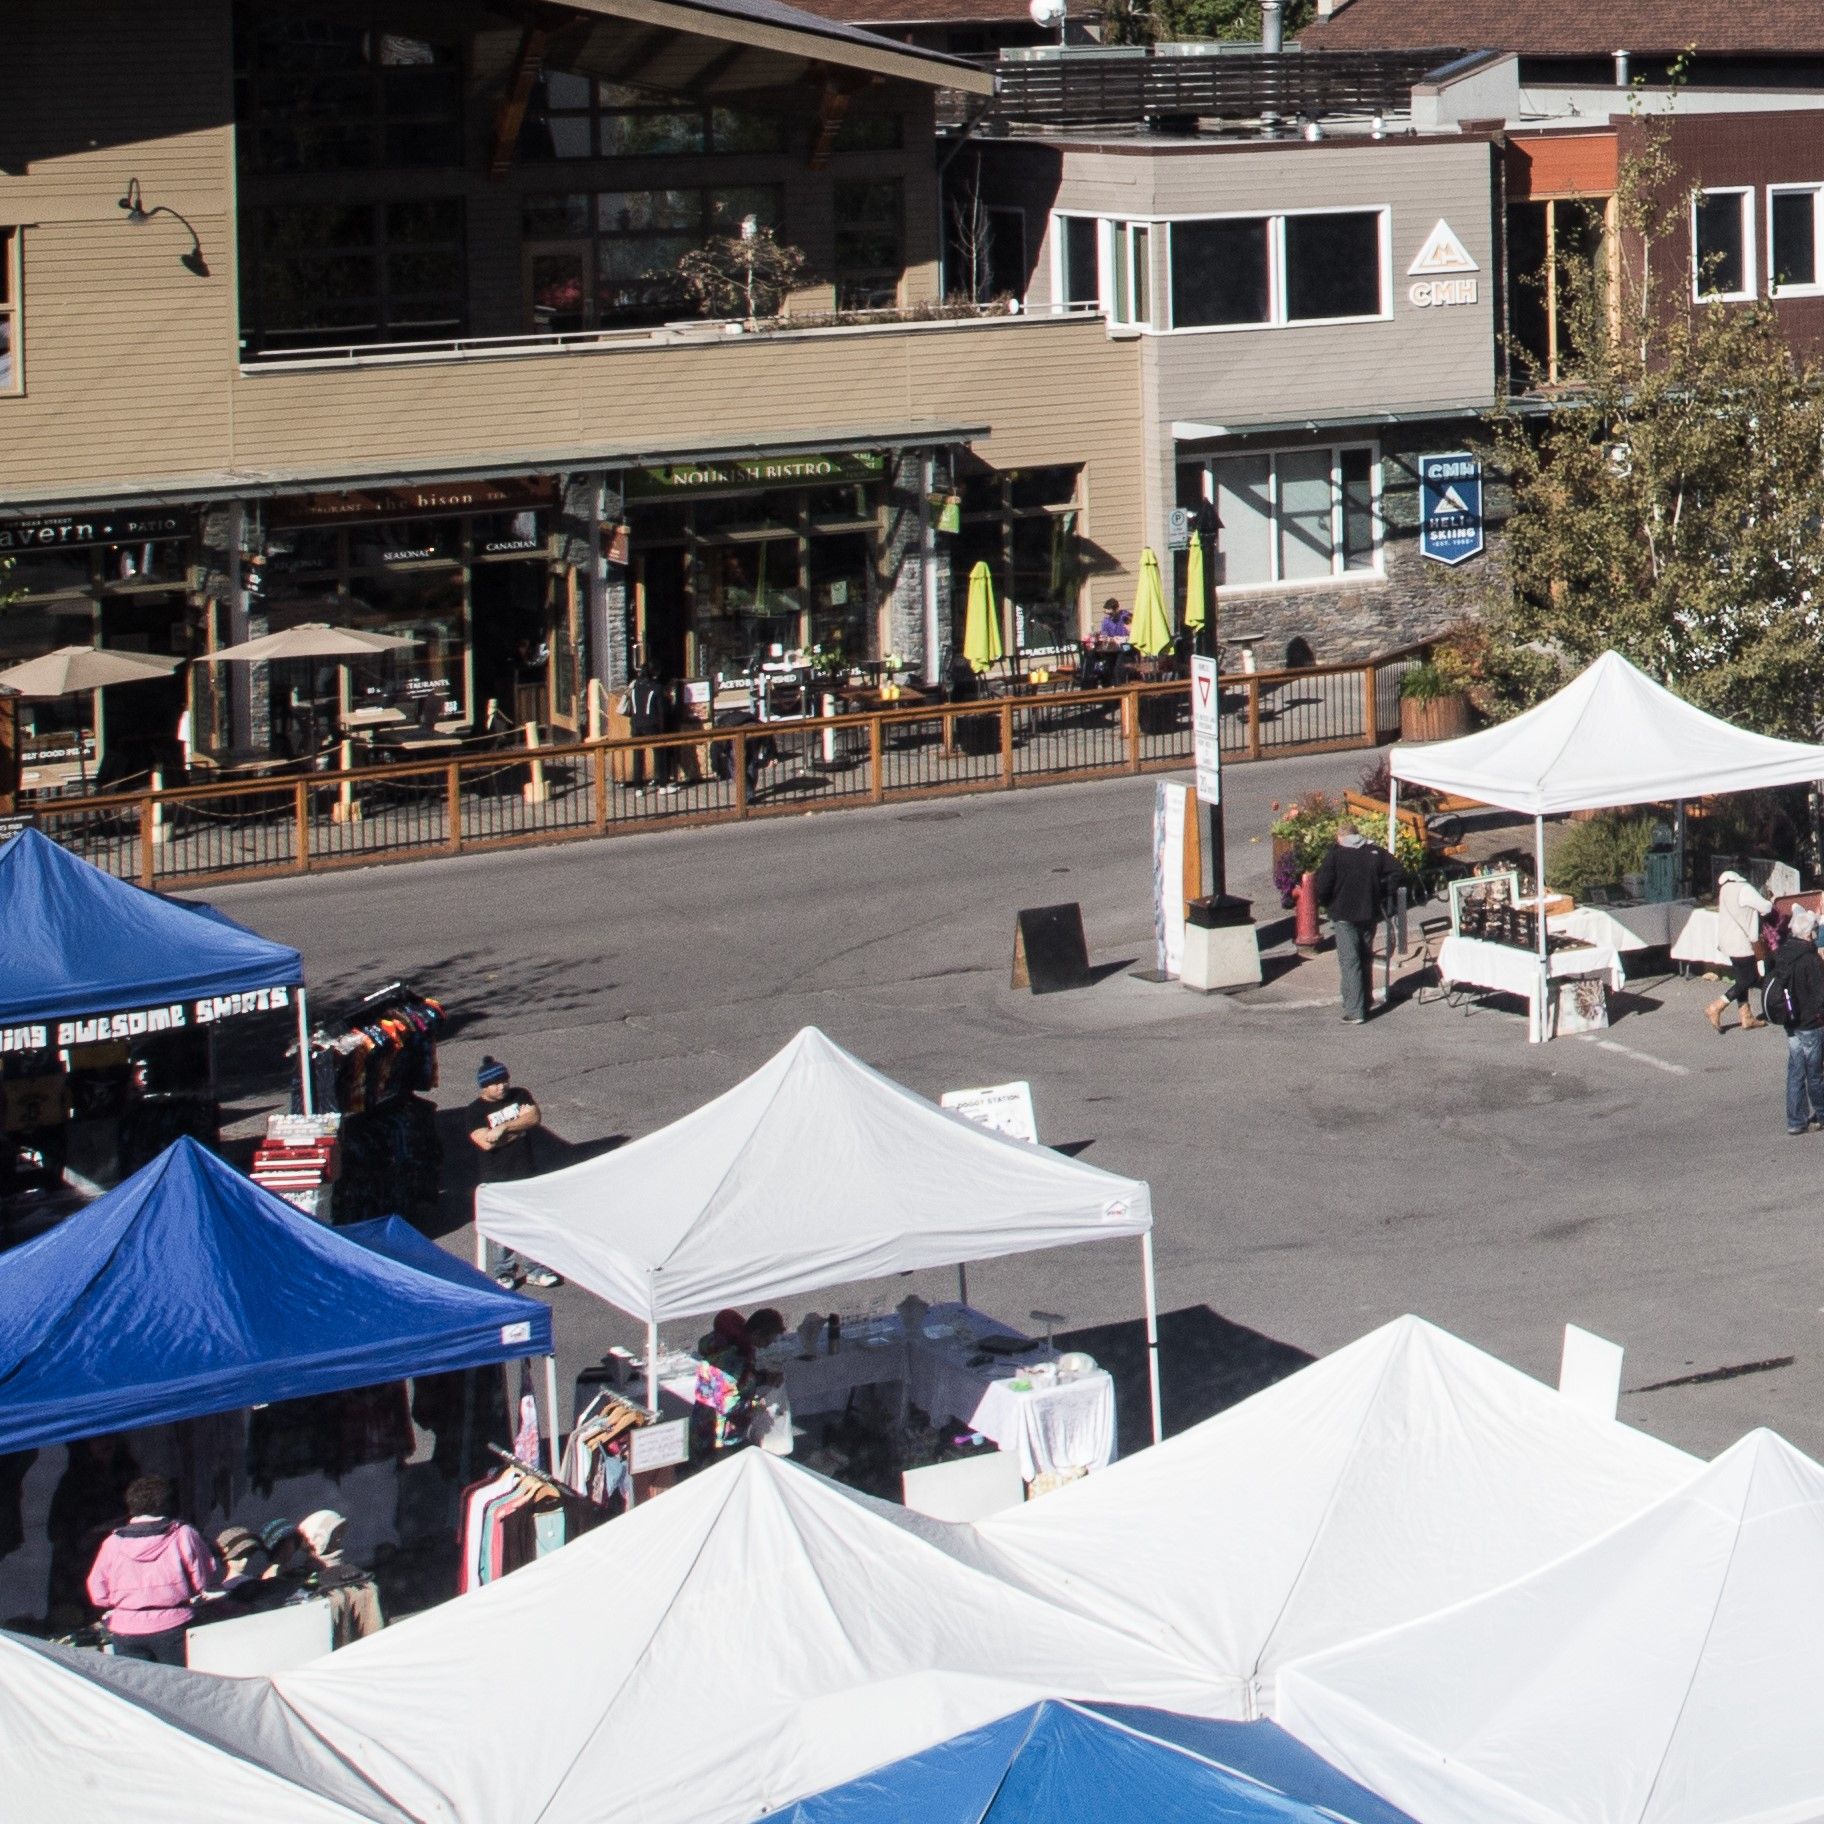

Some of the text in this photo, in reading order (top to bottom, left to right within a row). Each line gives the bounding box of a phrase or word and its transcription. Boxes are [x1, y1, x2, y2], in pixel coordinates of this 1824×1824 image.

[1409, 279, 1478, 308] CMH
[673, 468, 760, 486] NOURISH
[767, 462, 831, 478] BISTRO
[1428, 462, 1475, 480] CMH
[417, 493, 473, 507] bison
[128, 518, 176, 532] PATIO
[1430, 527, 1476, 541] SKIING
[486, 540, 537, 552] CANADIAN
[383, 549, 432, 561] SEASONAL
